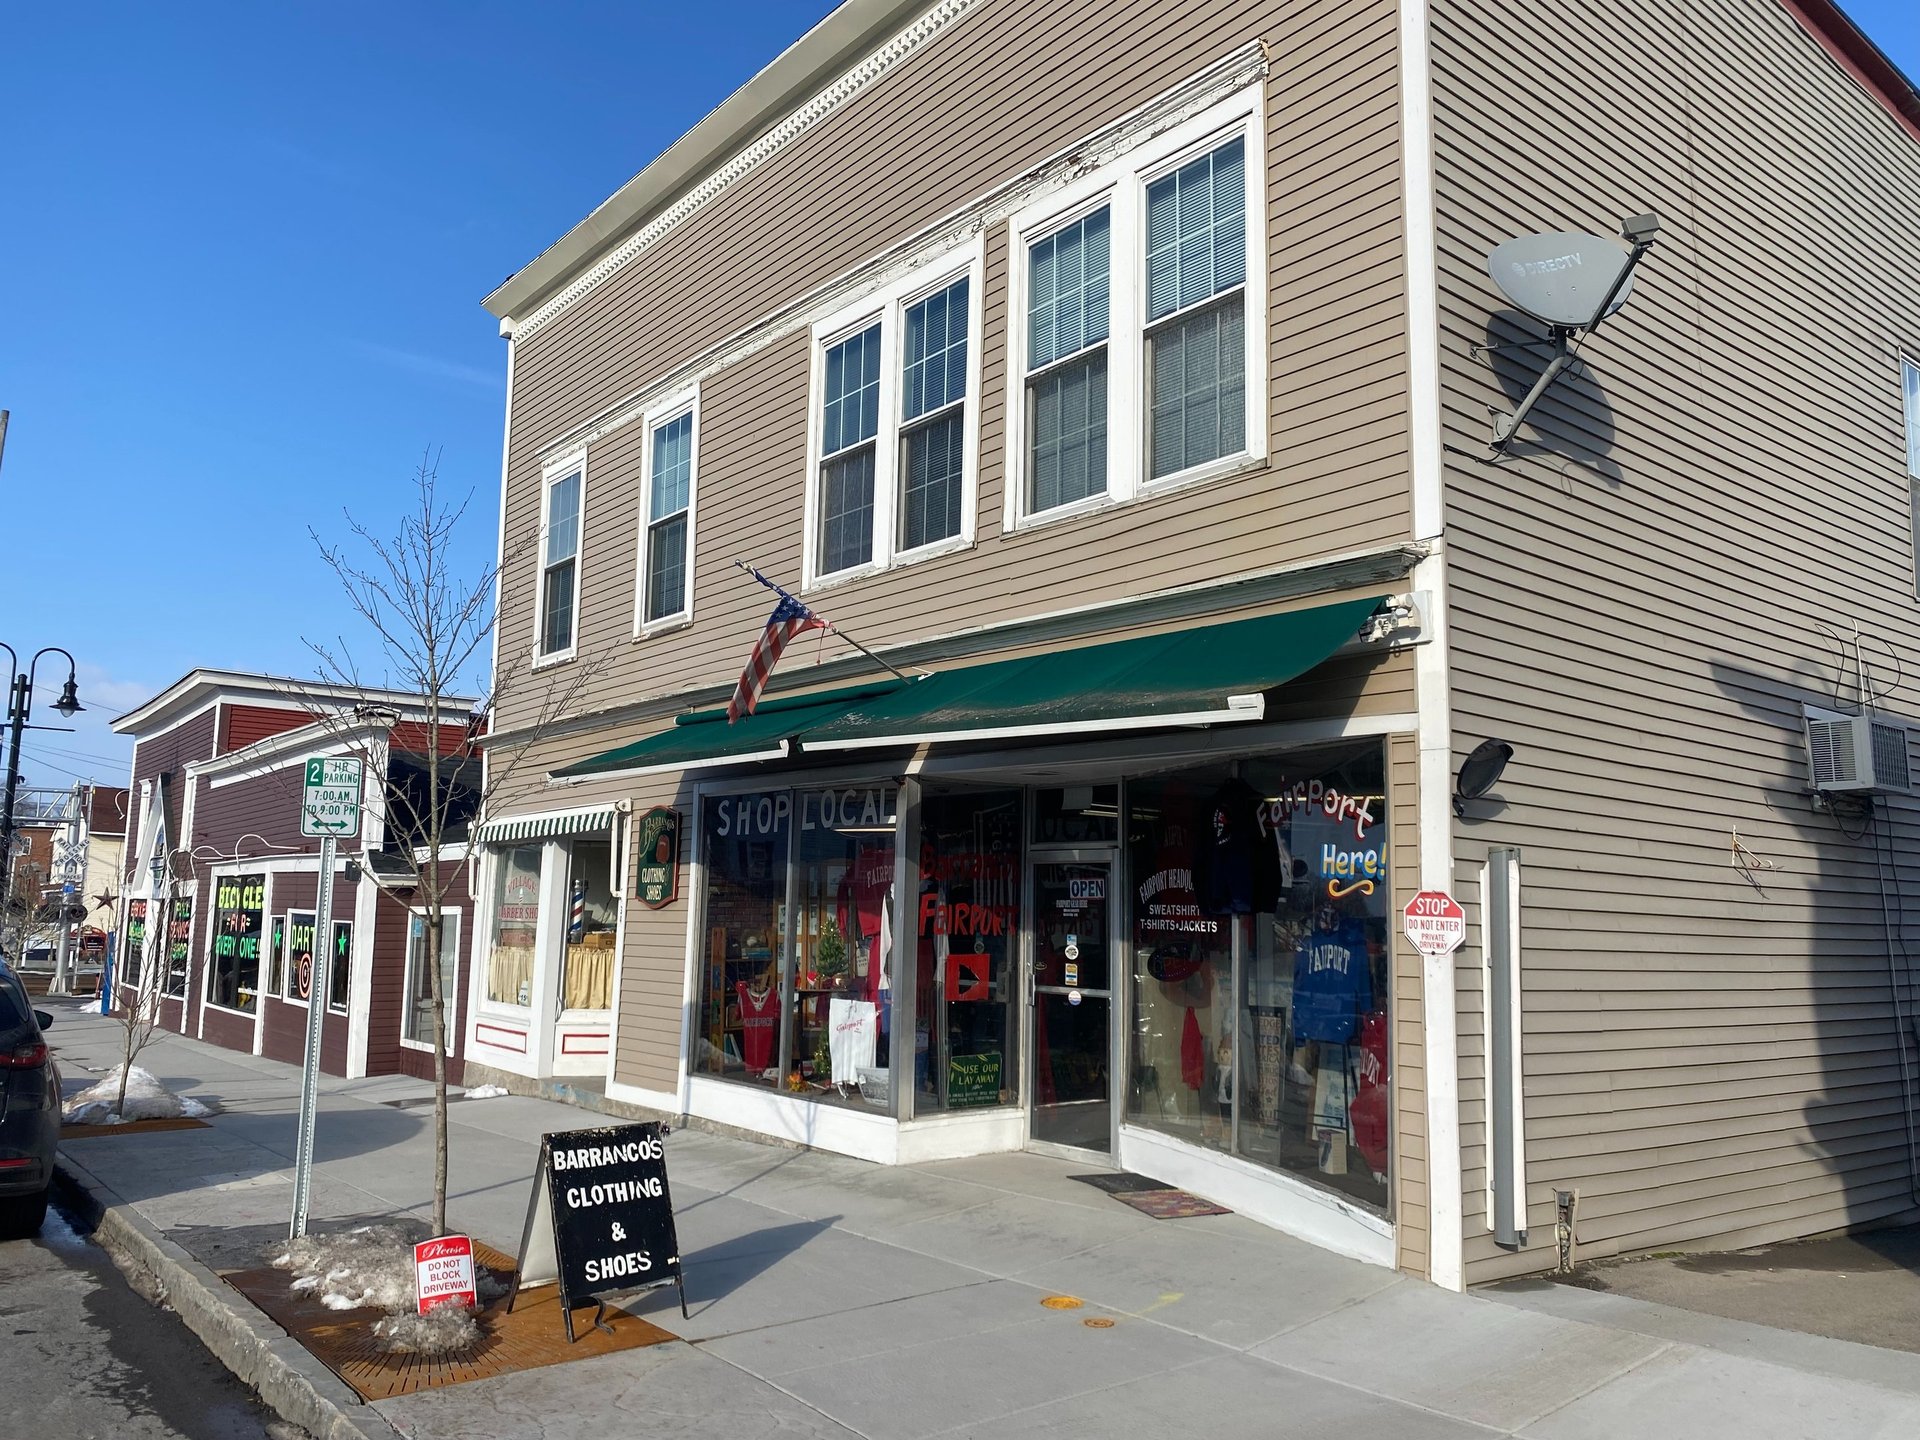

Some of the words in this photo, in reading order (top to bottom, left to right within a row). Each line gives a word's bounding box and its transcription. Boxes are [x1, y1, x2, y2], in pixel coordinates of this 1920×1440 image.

[1525, 252, 1582, 276] DIRECTV
[310, 762, 320, 782] 2
[333, 761, 349, 772] HR
[324, 772, 358, 784] PARKING
[314, 790, 334, 801] 7:00
[338, 791, 350, 801] AM
[307, 804, 317, 815] TO
[320, 804, 340, 815] 9:00
[343, 804, 355, 816] PM
[716, 795, 791, 837] SHOP
[801, 787, 897, 831] LOCAL
[1256, 775, 1374, 840] Fairport
[1321, 842, 1387, 879] Here!
[641, 867, 665, 884] CLOTHING
[866, 864, 895, 889] FAIRPO
[508, 876, 537, 895] VILLAGE
[645, 884, 662, 901] SHOES
[1071, 881, 1105, 898] OPEN
[1139, 870, 1168, 904] FAIRPORT
[1168, 868, 1195, 893] HEADQU
[525, 908, 539, 919] SHO
[1415, 897, 1450, 916] STOP
[1140, 918, 1175, 931] T-SHIRTS
[1178, 920, 1218, 933] JACKETS
[1409, 919, 1418, 930] DO
[1420, 920, 1434, 931] NOT
[1436, 921, 1459, 932] ENTER
[216, 935, 236, 957] EVERY
[291, 925, 317, 952] DART
[1420, 941, 1448, 949] DRIVEWAY
[1421, 933, 1445, 942] PRIVATE
[963, 1064, 979, 1074] USE
[982, 1063, 999, 1073] OUR
[958, 1075, 973, 1085] LAY
[975, 1073, 995, 1084] AWAY
[552, 1134, 663, 1171] BARRANCO'S
[566, 1177, 663, 1209] CLOTHING
[611, 1221, 627, 1241] &
[422, 1244, 465, 1259] Please
[428, 1262, 441, 1271] DO
[443, 1260, 460, 1268] NOT
[585, 1250, 652, 1282] SHOES
[430, 1270, 460, 1282] BLOCK
[423, 1281, 468, 1294] DRIVEWAY
